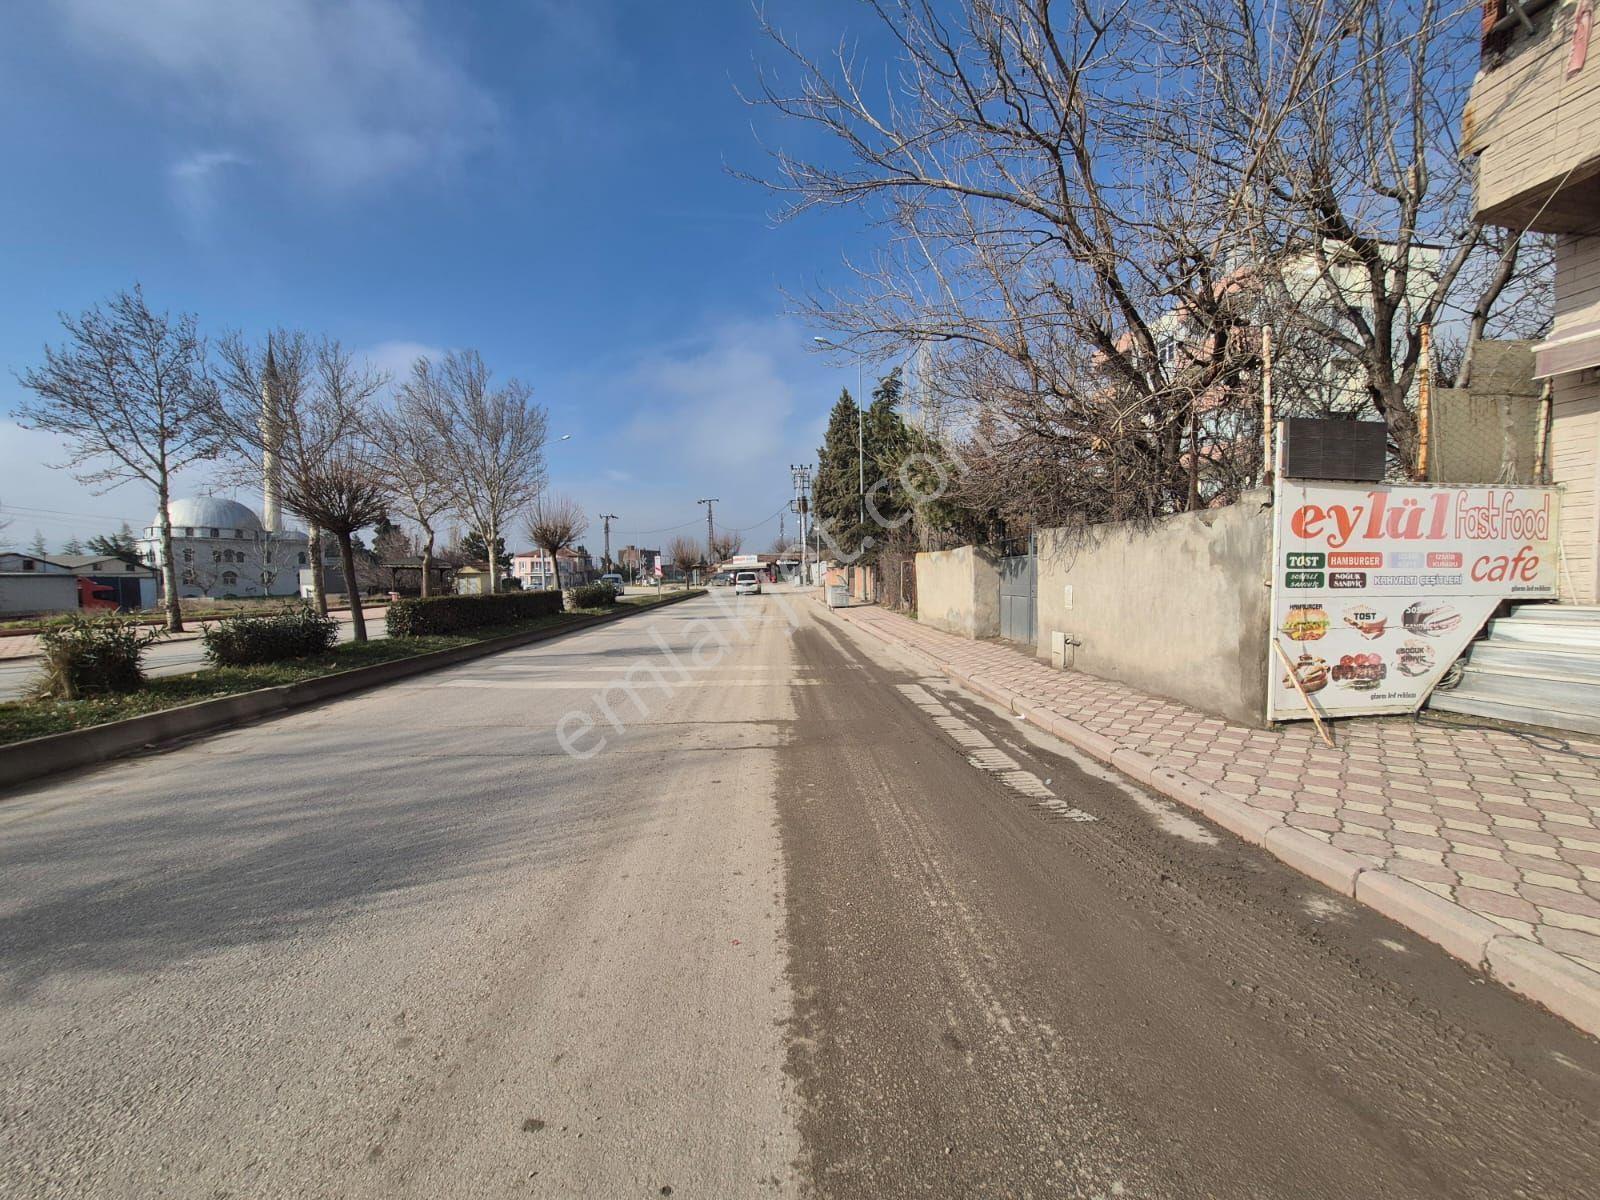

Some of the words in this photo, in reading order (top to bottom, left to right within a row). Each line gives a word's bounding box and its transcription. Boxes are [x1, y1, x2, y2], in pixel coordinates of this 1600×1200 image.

[1291, 490, 1450, 549] eylül
[1455, 490, 1500, 540] fast
[1501, 491, 1549, 541] food
[1289, 555, 1320, 567] TOST
[1330, 555, 1381, 566] HAMBURGER
[1470, 545, 1540, 583] cafe
[1373, 575, 1417, 585] KAHVALTI
[1419, 573, 1462, 587] ÇEŞİTLERİ
[1353, 612, 1377, 621] TOST
